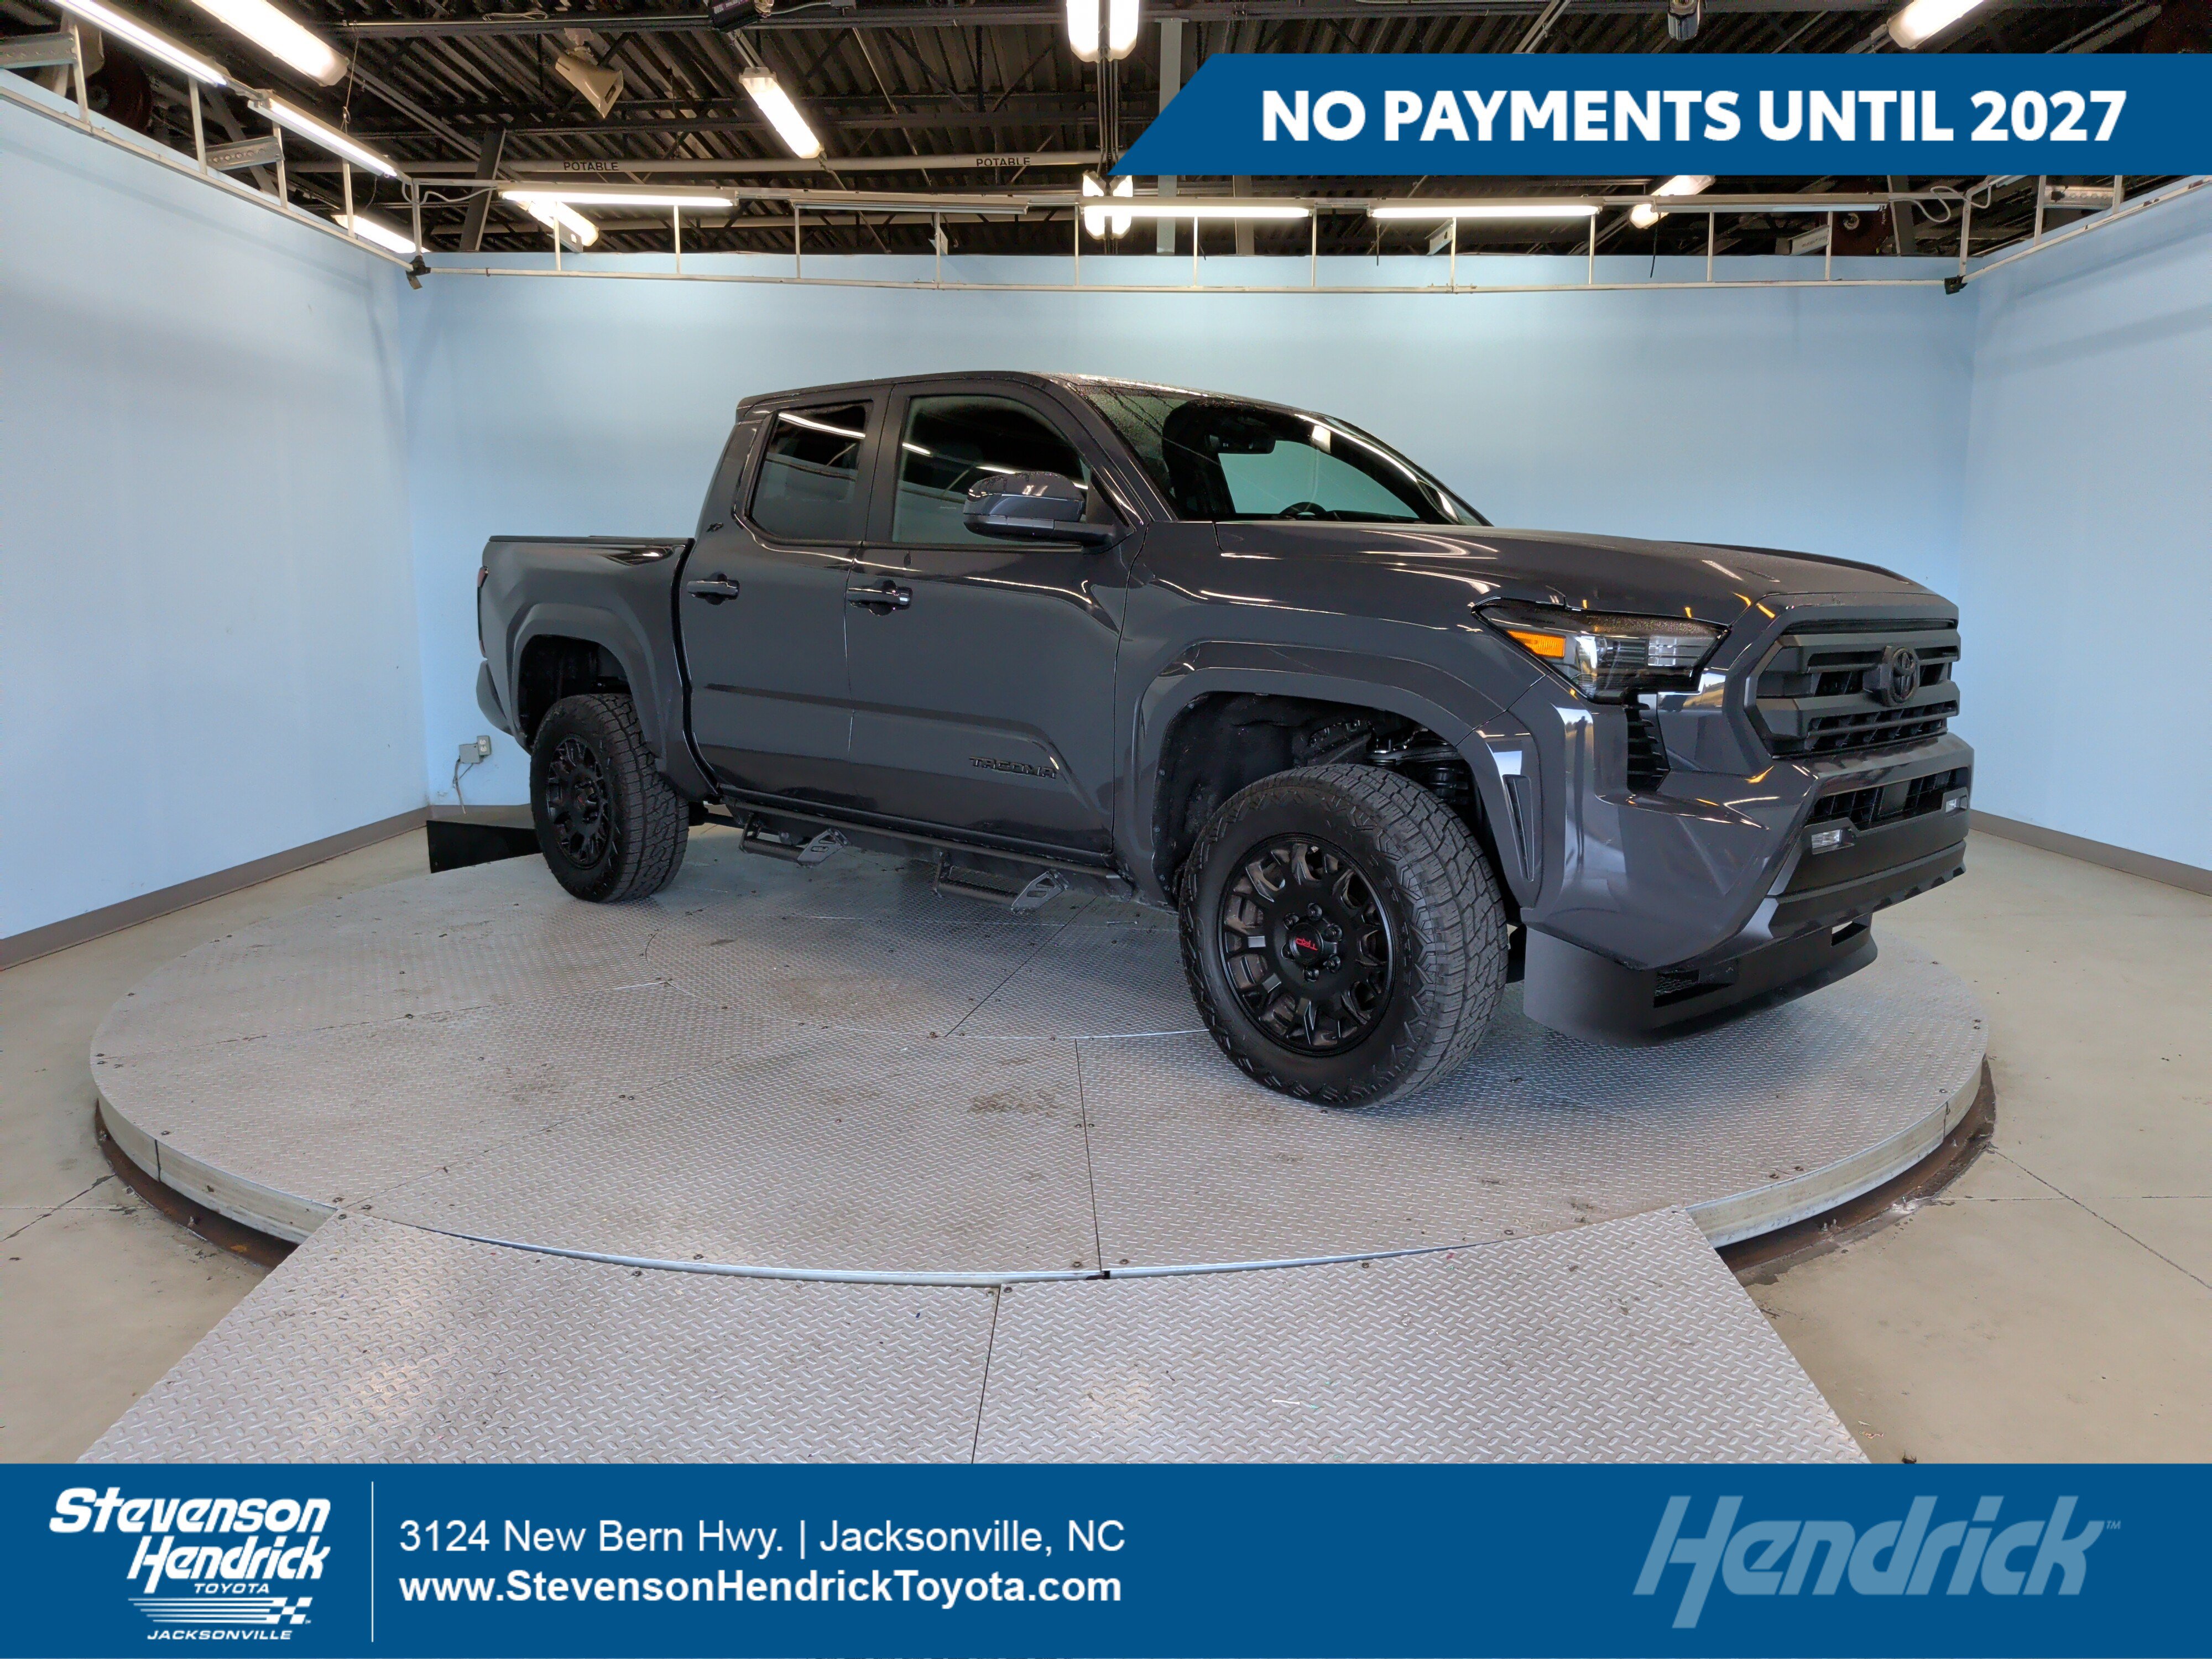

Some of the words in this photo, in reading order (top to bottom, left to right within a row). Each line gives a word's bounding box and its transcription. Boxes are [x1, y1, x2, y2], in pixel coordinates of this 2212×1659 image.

[563, 161, 619, 171] POTABLE
[976, 157, 1031, 166] POTABLE
[969, 755, 1057, 779] TACOMA
[1296, 937, 1318, 951] TRD
